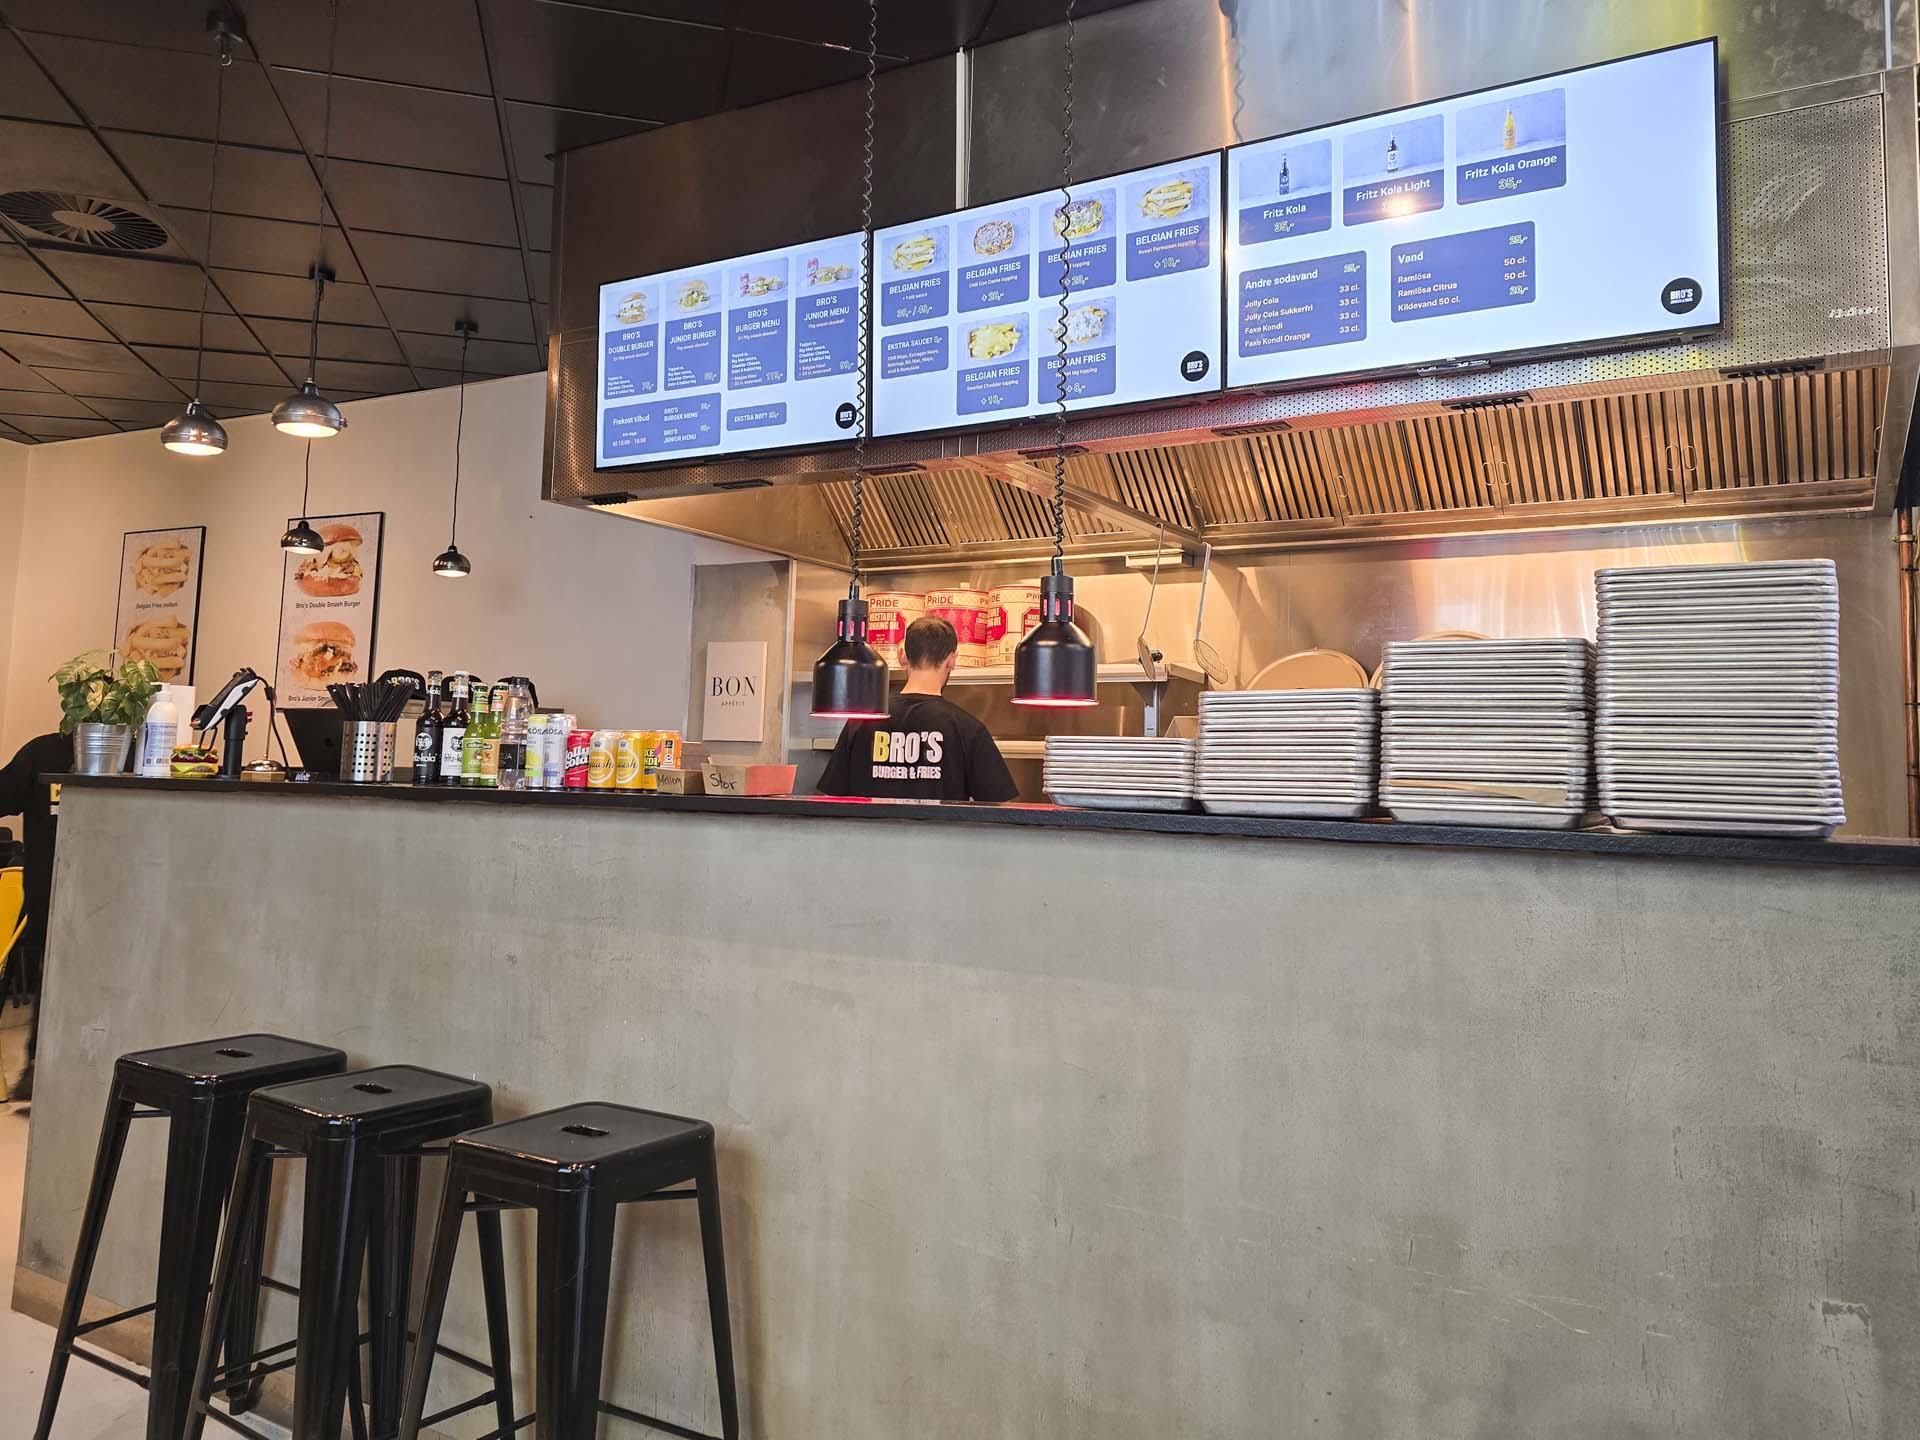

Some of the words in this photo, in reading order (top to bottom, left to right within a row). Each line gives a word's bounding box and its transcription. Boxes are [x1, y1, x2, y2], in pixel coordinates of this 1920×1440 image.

[1465, 168, 1488, 180] Fritz
[1491, 162, 1515, 174] Kola
[1518, 155, 1557, 169] Orange
[1356, 190, 1378, 201] Fritz
[1380, 185, 1402, 196] Kola
[1405, 179, 1430, 192] Light
[1263, 208, 1284, 220] Fritz
[1286, 204, 1306, 214] Kola
[1136, 230, 1172, 246] BELGIAN
[1174, 225, 1200, 237] FRIES
[1084, 244, 1107, 256] FRIES
[1398, 251, 1424, 264] Vand
[966, 266, 998, 279] BELGIAN
[1000, 261, 1021, 272] FRIES
[1504, 272, 1515, 280] 50
[1245, 278, 1272, 290] Andre
[1274, 270, 1318, 285] sodavand
[1398, 272, 1432, 283] Ramlösa
[889, 283, 919, 294] BELGIAN
[920, 278, 940, 288] FRIES
[1398, 286, 1431, 297] Ramlösa
[1433, 282, 1458, 292] Citrus
[816, 296, 837, 306] BRO'S
[1245, 299, 1261, 308] Jolly
[1398, 300, 1437, 311] Kildevand
[1439, 297, 1450, 305] 50
[748, 308, 768, 319] BRO'S
[804, 310, 828, 321] JUNIOR
[830, 306, 850, 317] MENU
[1245, 312, 1261, 321] Jolly
[1263, 310, 1279, 318] Cola
[1280, 304, 1313, 315] Sukkerfri
[684, 320, 702, 330] BRO'S
[736, 322, 760, 333] BURGER
[762, 318, 780, 329] MENU
[1263, 322, 1282, 331] Kondi
[623, 331, 641, 340] BRO'S
[669, 334, 692, 344] JUNIOR
[692, 330, 717, 340] BURGER
[1263, 336, 1282, 345] Kondi
[1284, 333, 1311, 342] Orange
[608, 343, 630, 354] DOUBLE
[631, 341, 654, 351] BURGER
[888, 341, 909, 350] EKSTRA
[1083, 353, 1106, 364] FRIES
[966, 370, 997, 382] BELGIAN
[999, 366, 1020, 377] FRIES
[870, 599, 898, 608] PRIDE
[927, 595, 954, 604] PRIDE
[711, 676, 760, 697] BON
[872, 730, 944, 764] BRO'S
[872, 765, 908, 779] BURGER
[909, 766, 916, 779] &
[916, 766, 941, 779] FRIES
[710, 773, 736, 790] Stor
